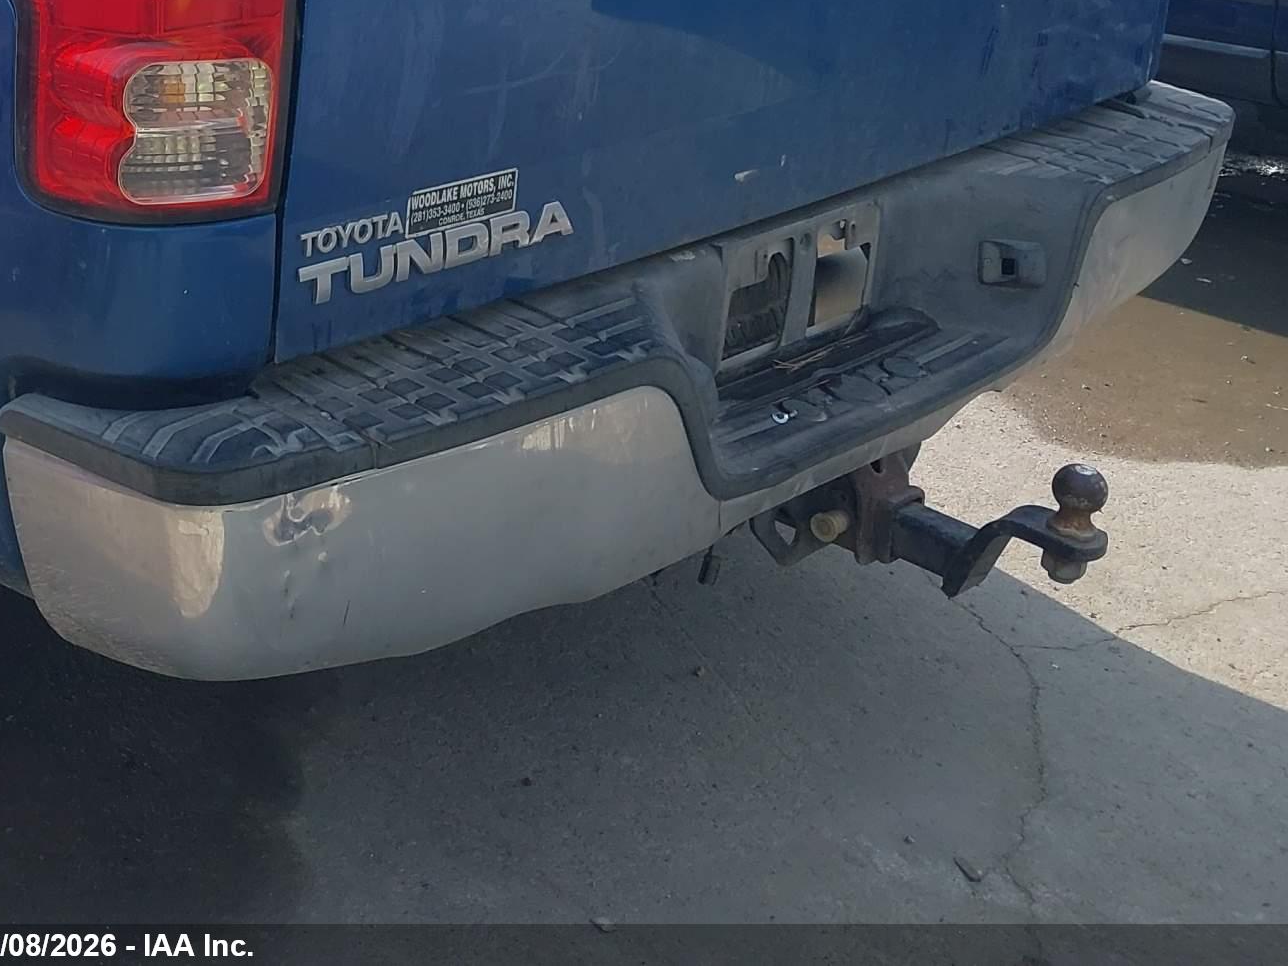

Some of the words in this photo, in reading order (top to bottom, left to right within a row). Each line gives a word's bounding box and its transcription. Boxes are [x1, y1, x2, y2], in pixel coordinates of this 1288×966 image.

[411, 186, 458, 210] WOODLAKE
[497, 174, 514, 190] INC.
[300, 211, 404, 257] TOYOTA
[466, 209, 485, 220] TEXAS
[299, 201, 573, 304] TUNDRA
